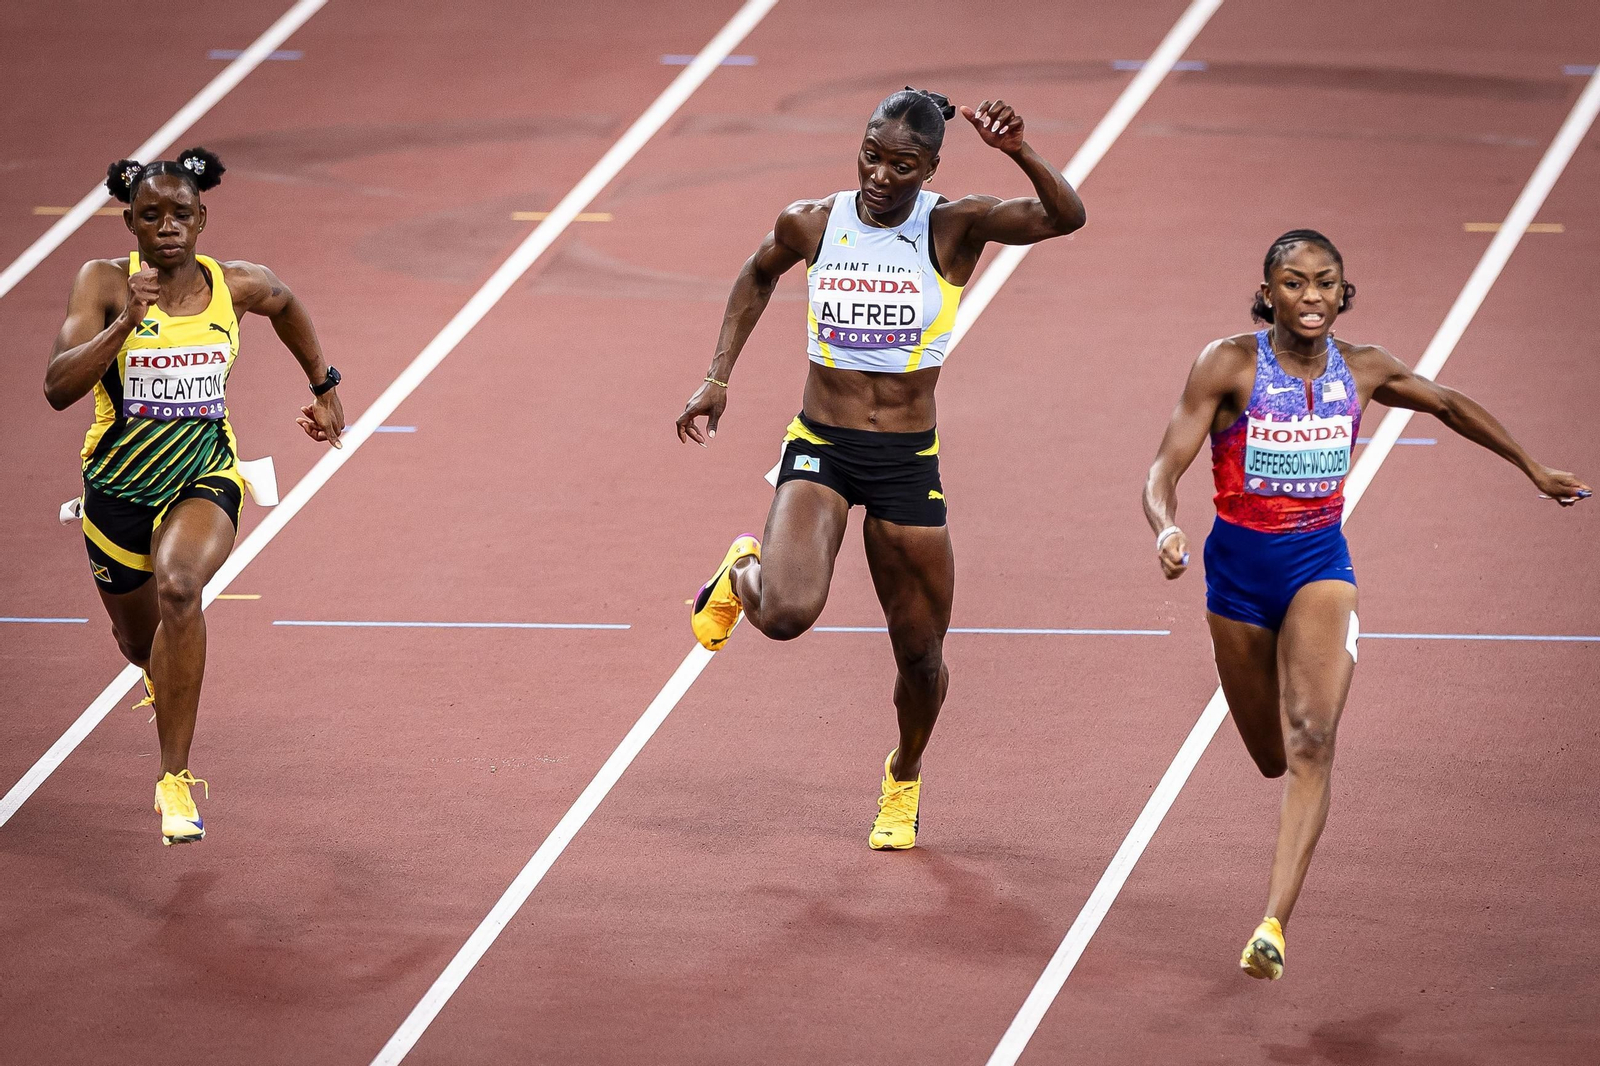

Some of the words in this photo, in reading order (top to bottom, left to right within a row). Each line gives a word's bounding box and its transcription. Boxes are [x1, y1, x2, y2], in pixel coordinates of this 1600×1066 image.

[818, 277, 920, 294] HONDA
[821, 301, 916, 326] ALFRED
[128, 351, 227, 369] HONDA
[129, 377, 146, 398] Ti.
[151, 374, 222, 400] CLAYTON
[1250, 425, 1349, 443] HONDA
[1248, 449, 1348, 475] JEFFERSON-WOODEN
[1271, 480, 1337, 493] TOKYO2
